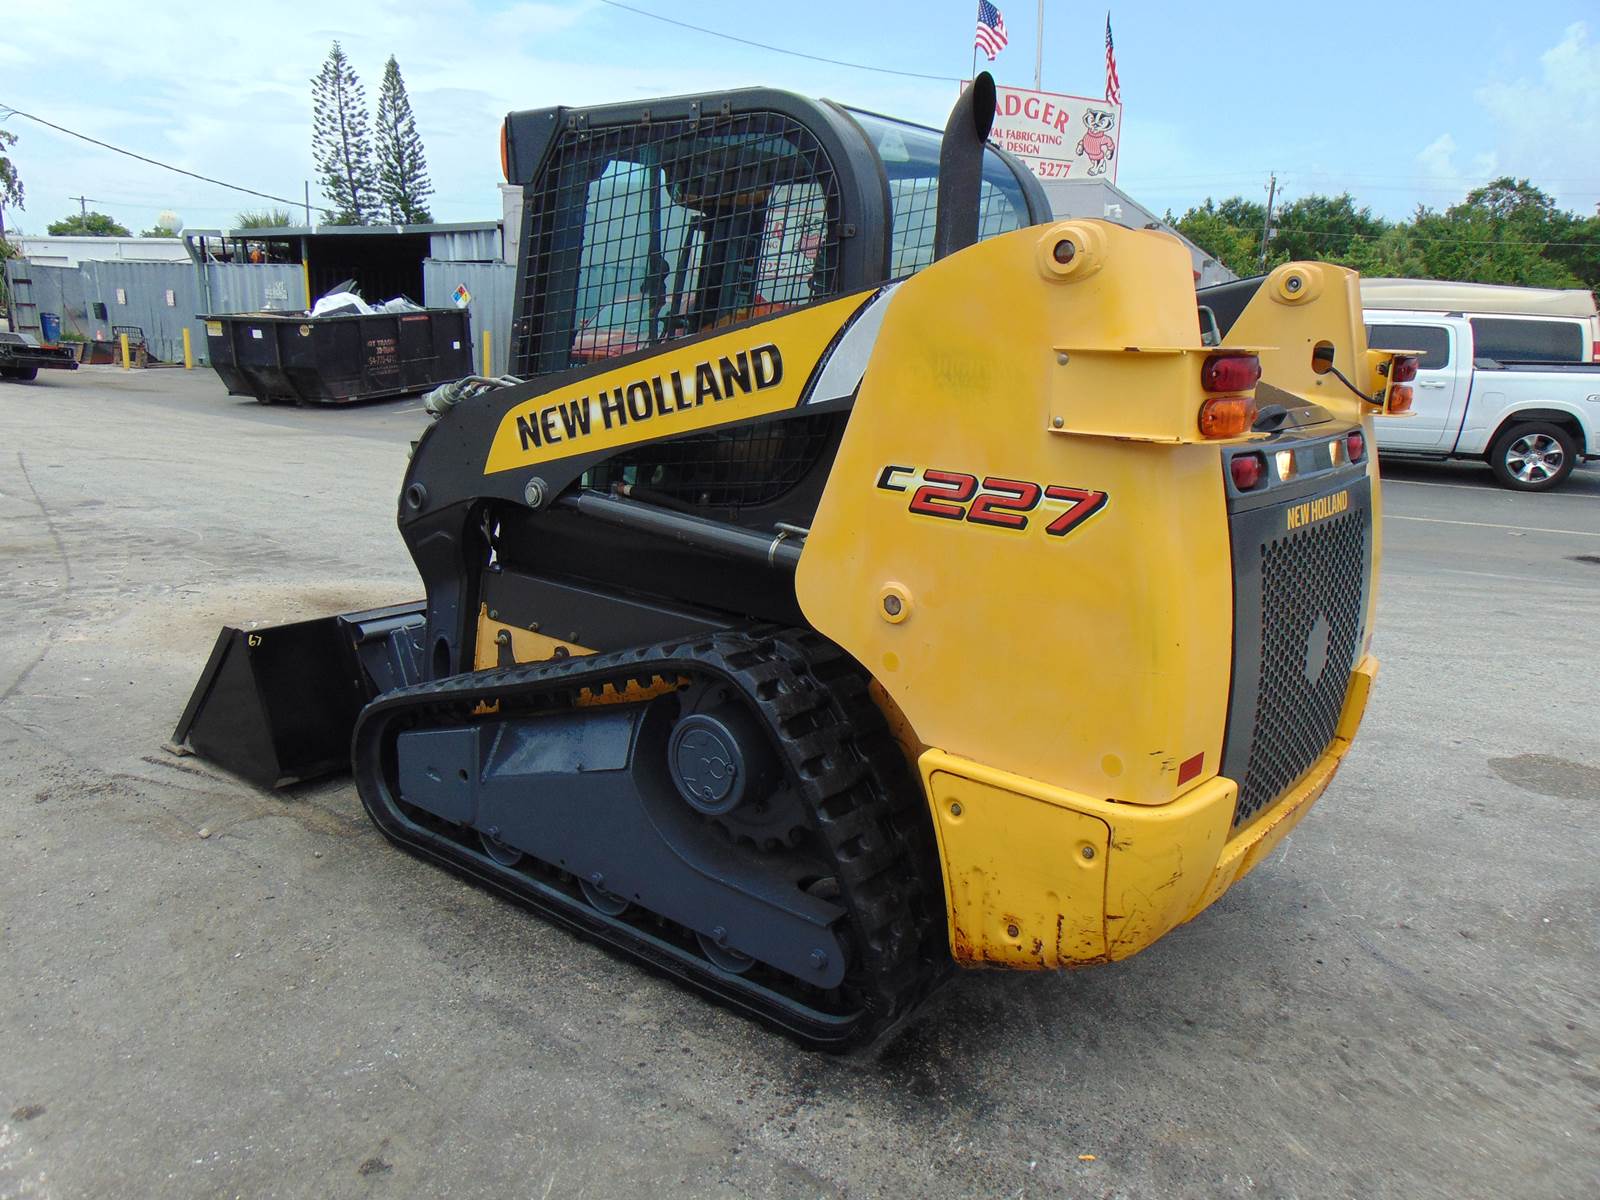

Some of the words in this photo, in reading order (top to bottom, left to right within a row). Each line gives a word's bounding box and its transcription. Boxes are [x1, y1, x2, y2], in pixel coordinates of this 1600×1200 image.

[1006, 129, 1062, 146] FABRICATING
[1007, 141, 1040, 154] DESIGN
[1038, 161, 1071, 178] 5277
[515, 396, 591, 452] NEW
[599, 343, 784, 430] HOLLAND
[1287, 502, 1310, 531] NEW
[1311, 489, 1348, 522] HOLLAND
